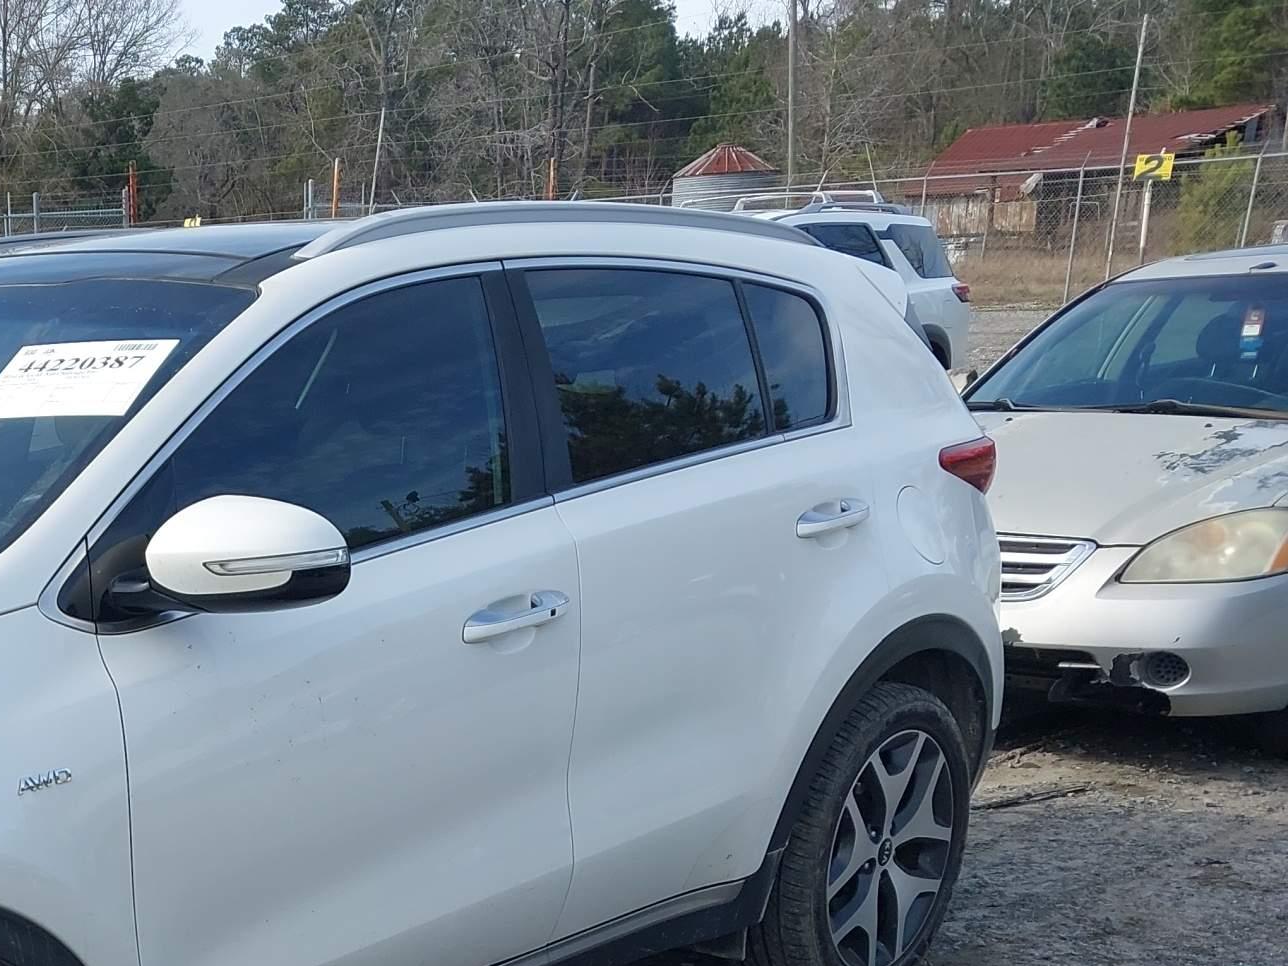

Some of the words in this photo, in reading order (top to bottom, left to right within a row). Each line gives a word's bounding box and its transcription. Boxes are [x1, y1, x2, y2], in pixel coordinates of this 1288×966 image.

[1135, 155, 1164, 181] 2
[18, 355, 146, 373] 44220387
[17, 768, 73, 796] AWD
[881, 841, 891, 865] KIA
